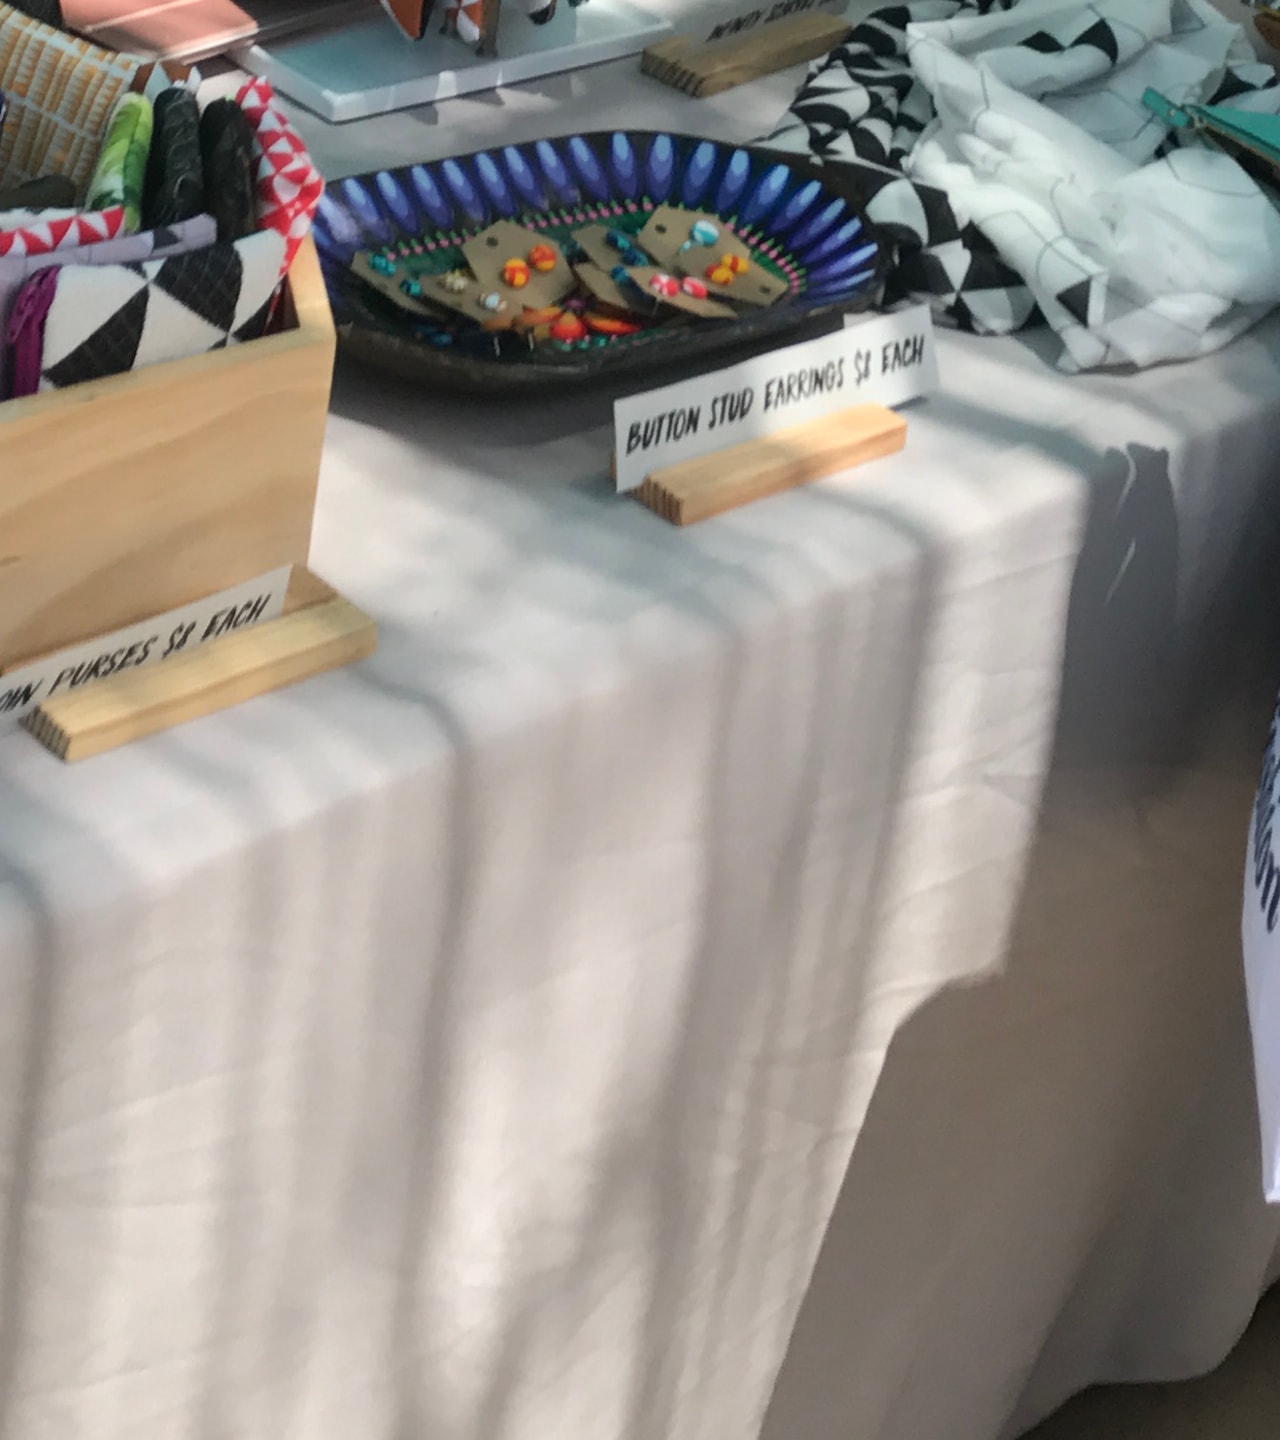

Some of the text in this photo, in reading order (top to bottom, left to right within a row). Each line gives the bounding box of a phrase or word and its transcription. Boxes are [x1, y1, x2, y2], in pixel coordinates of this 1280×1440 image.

[626, 405, 701, 456] BUTTON
[708, 387, 754, 431] STUD
[763, 356, 846, 411] EARRINGS
[881, 334, 926, 376] EACH
[47, 634, 159, 697] PURSES
[201, 592, 273, 642] EACH
